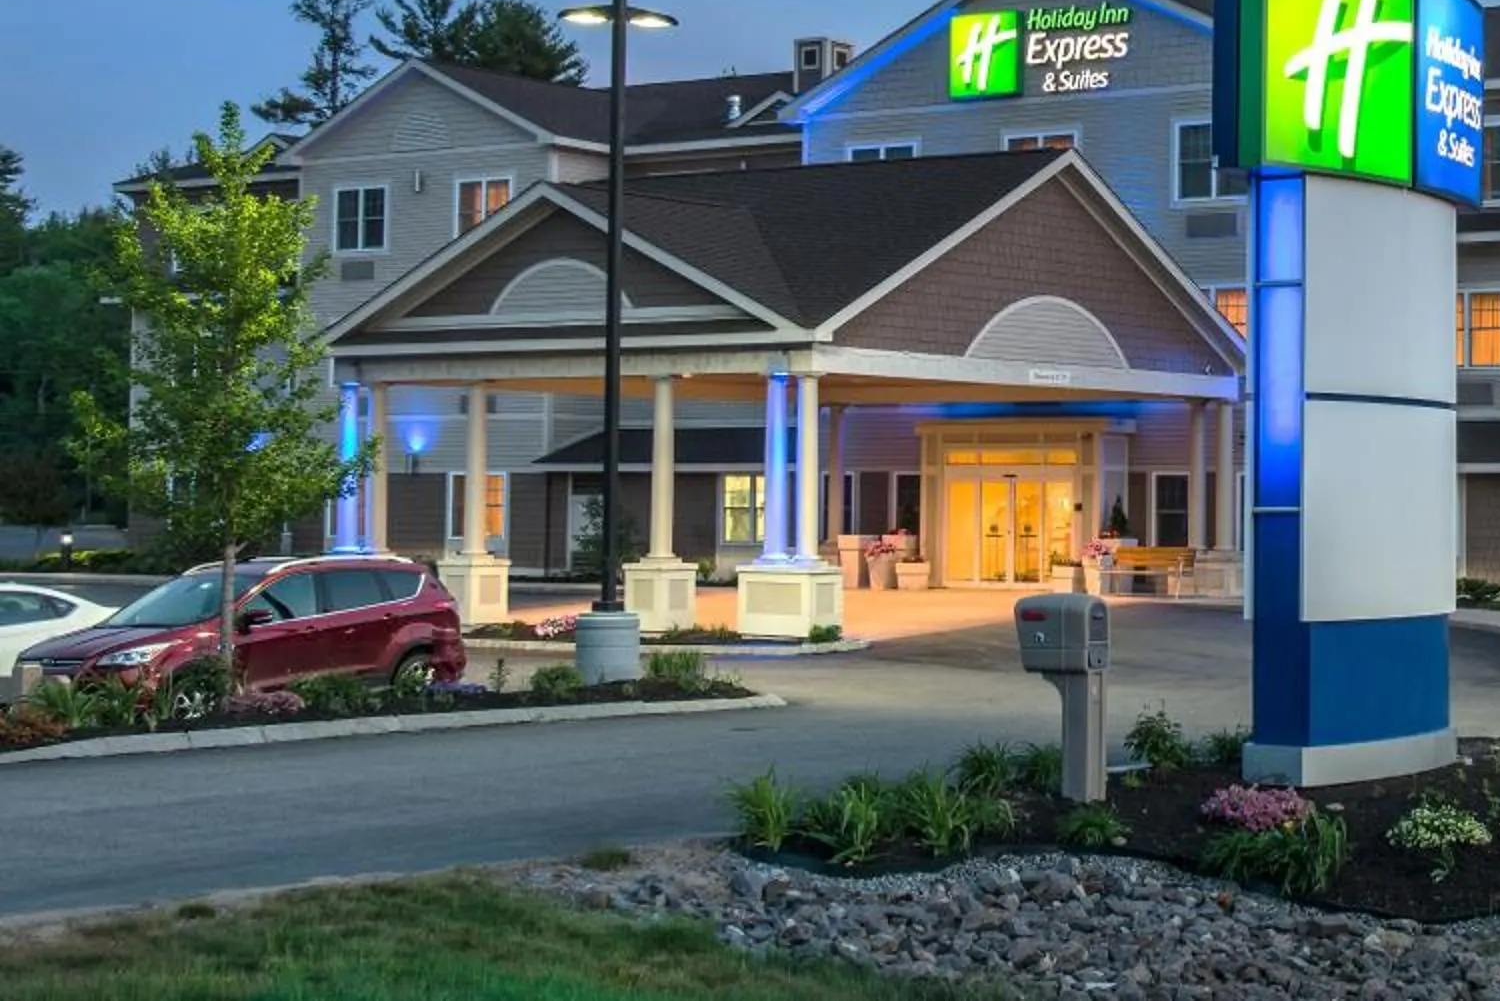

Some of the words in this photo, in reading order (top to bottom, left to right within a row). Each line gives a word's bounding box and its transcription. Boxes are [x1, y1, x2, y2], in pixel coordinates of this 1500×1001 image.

[1028, 5, 1097, 30] Holiday
[1100, 2, 1129, 24] Inn
[1026, 31, 1129, 69] Express
[1043, 72, 1056, 92] &
[1058, 70, 1109, 90] Suites
[1425, 66, 1482, 131] Express
[1437, 128, 1448, 157] &
[1449, 131, 1475, 168] Suites
